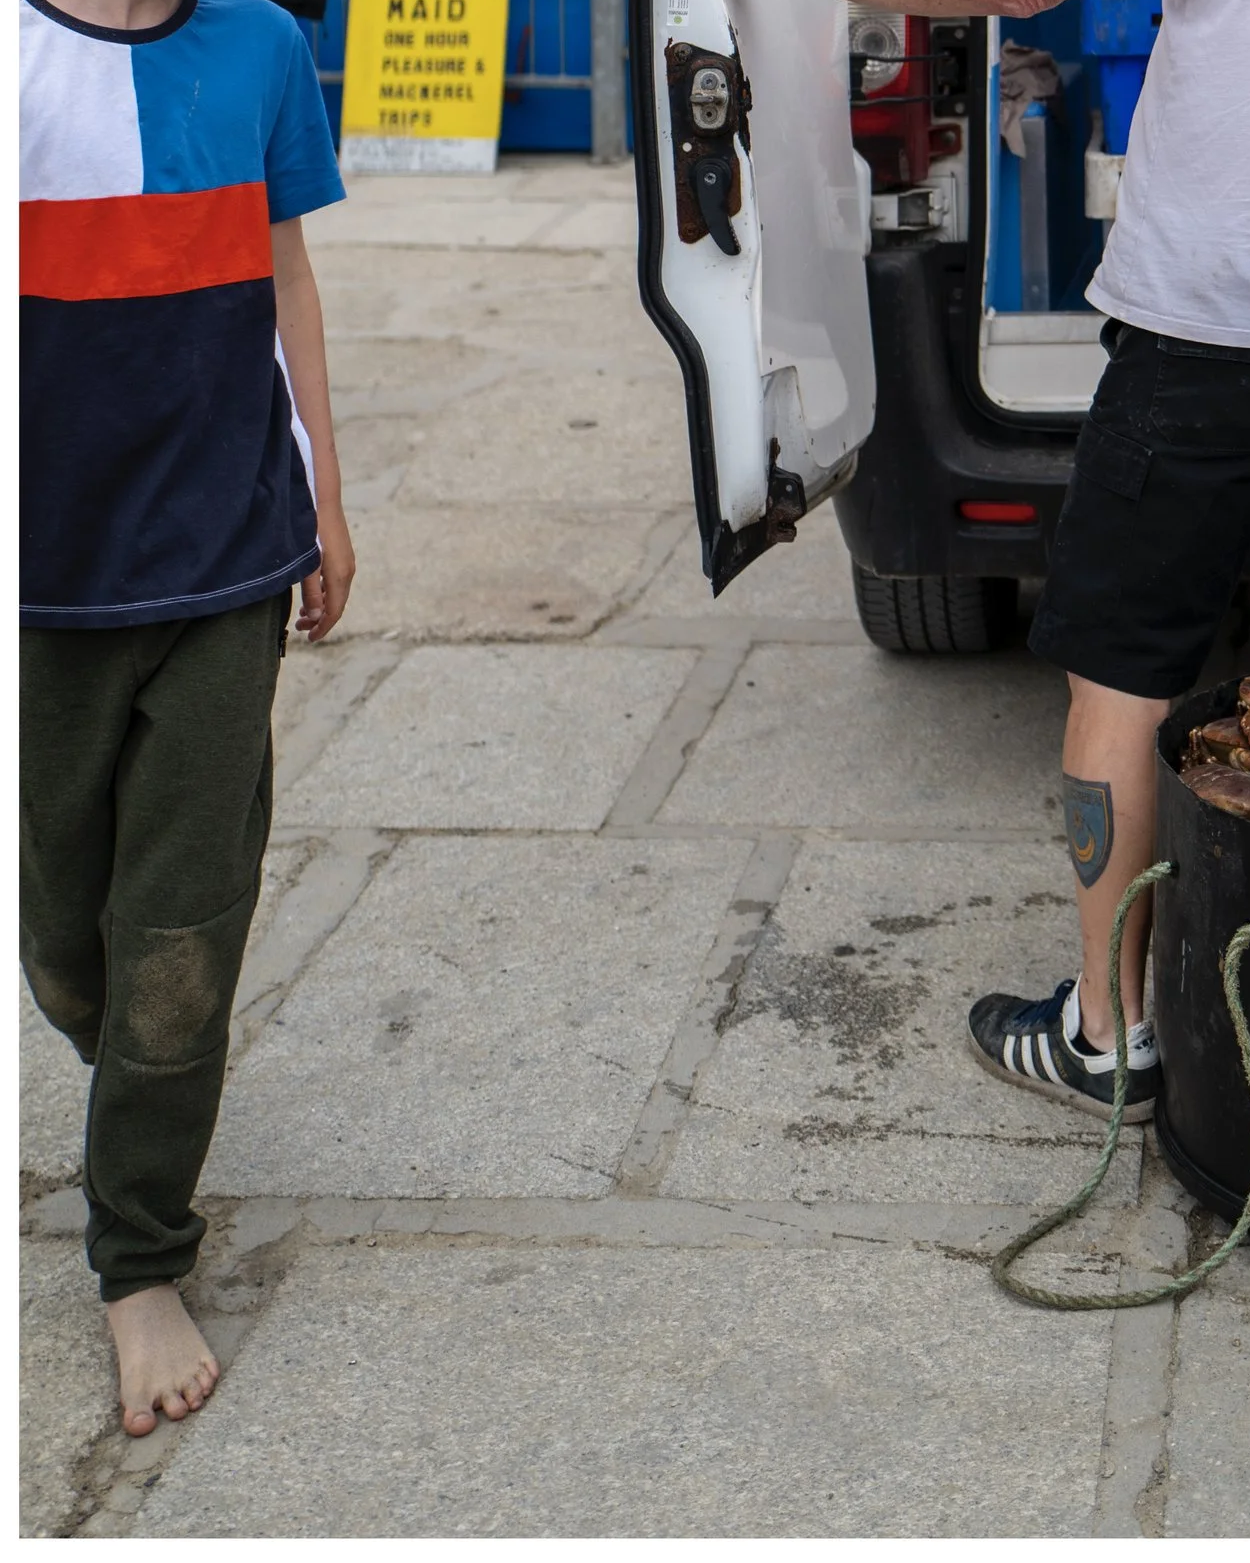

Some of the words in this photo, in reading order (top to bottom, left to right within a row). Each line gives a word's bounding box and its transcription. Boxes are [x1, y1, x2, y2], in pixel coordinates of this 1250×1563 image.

[384, 29, 415, 49] ONE
[424, 30, 469, 49] HOUR
[381, 56, 465, 75] PLEASURE
[379, 109, 432, 127] TRIPS
